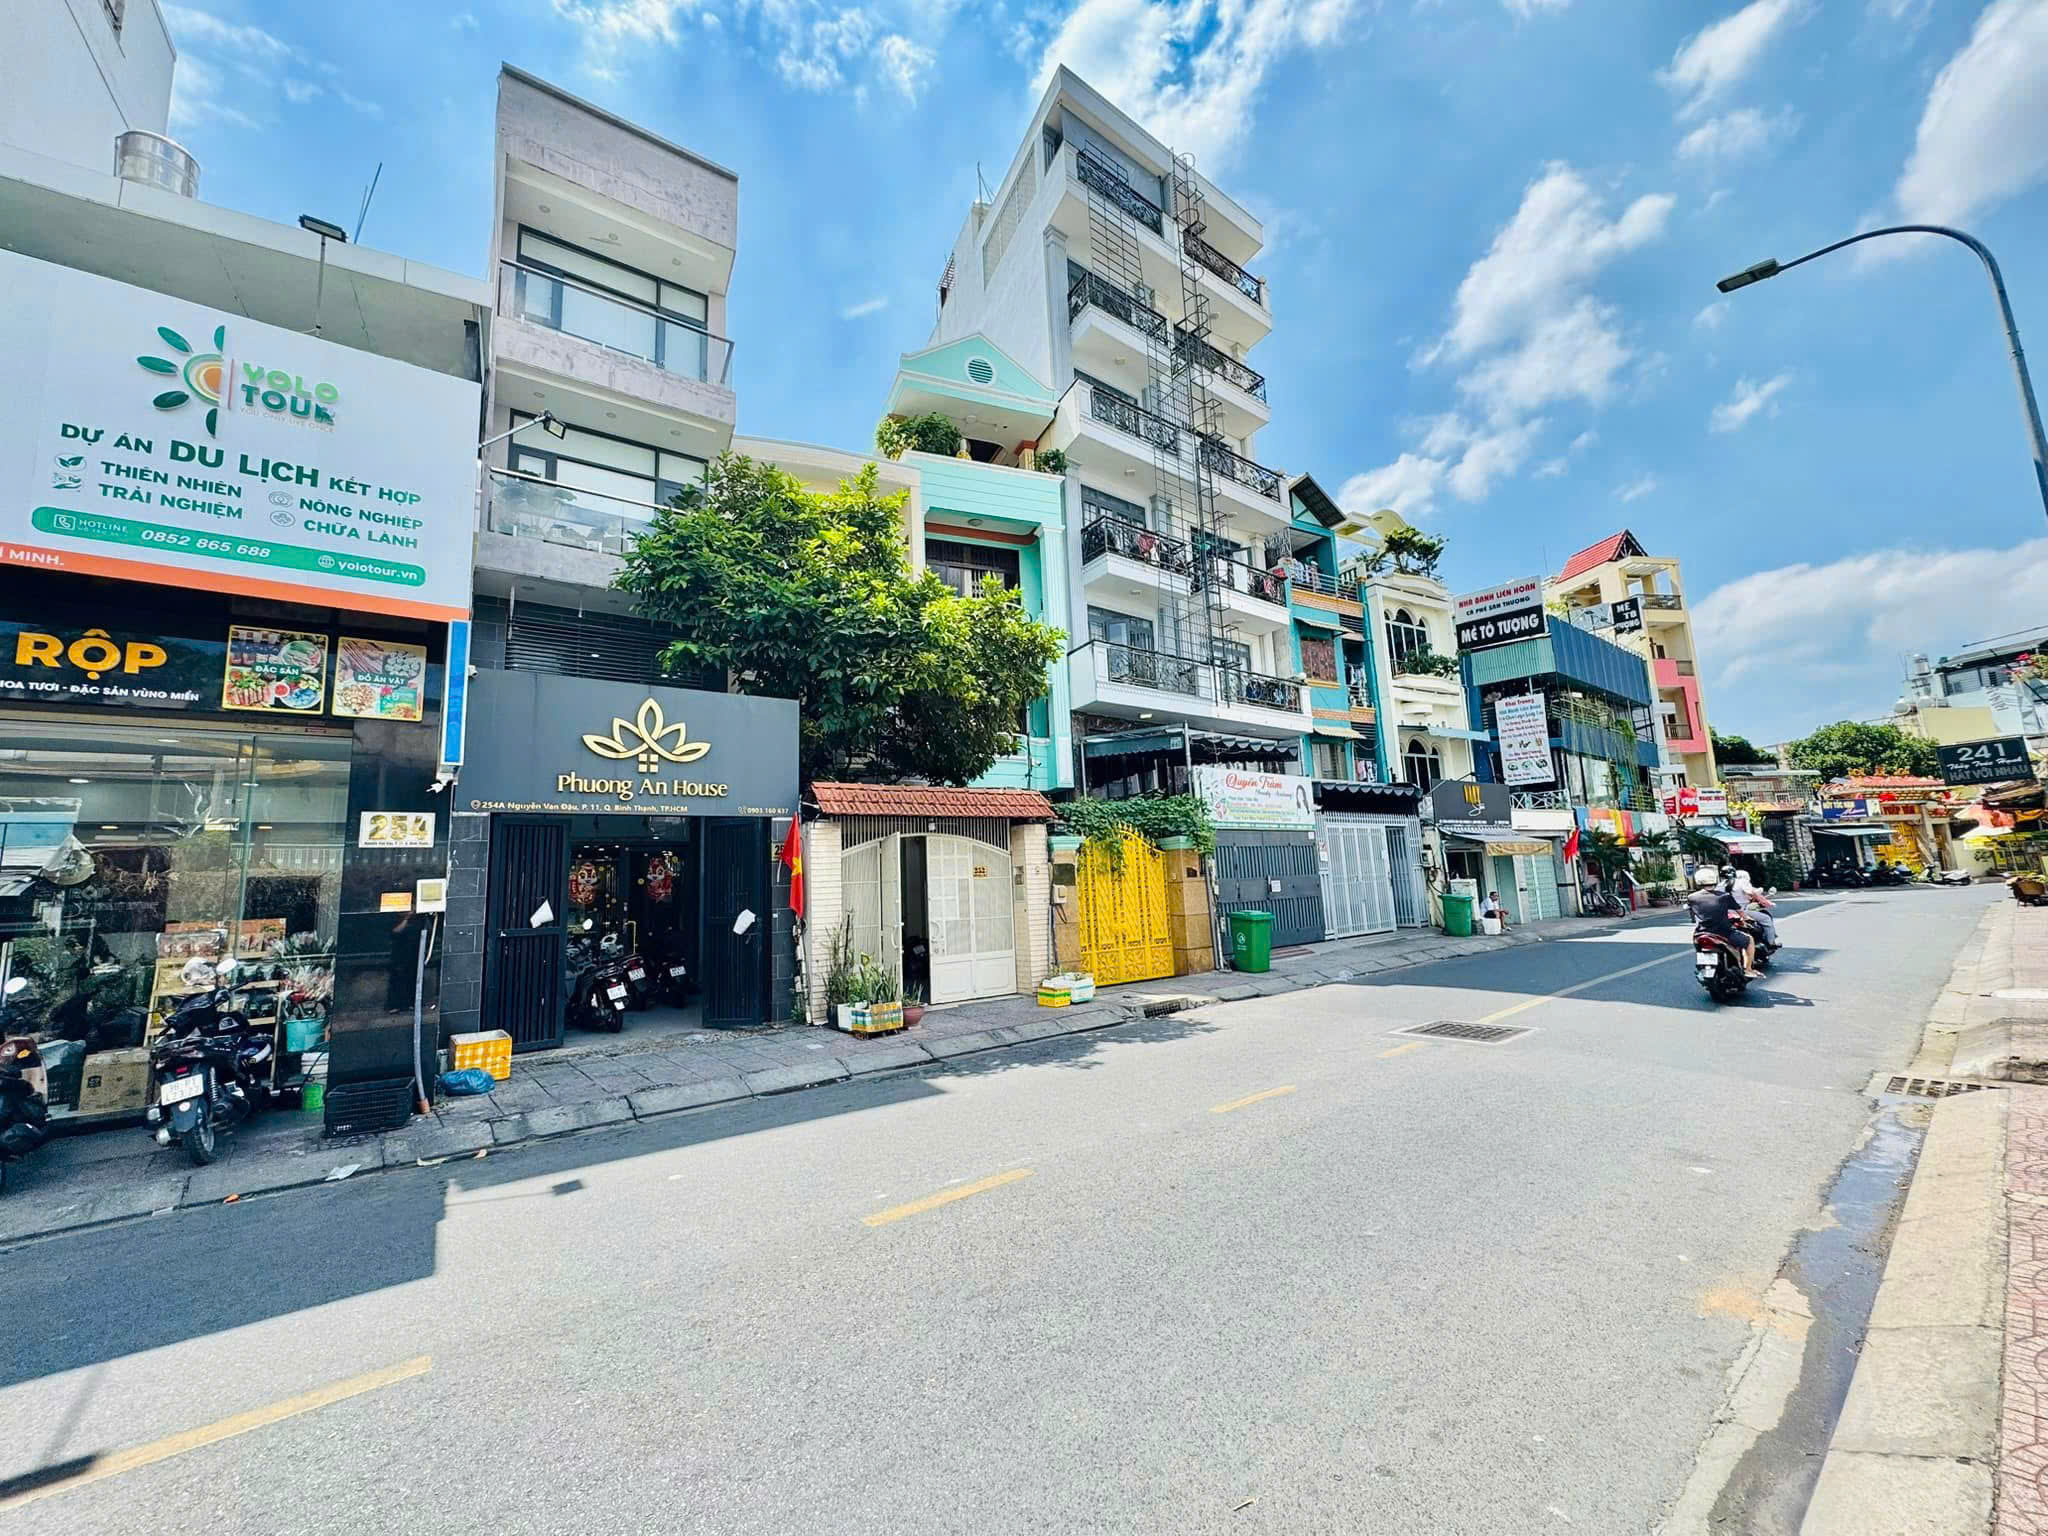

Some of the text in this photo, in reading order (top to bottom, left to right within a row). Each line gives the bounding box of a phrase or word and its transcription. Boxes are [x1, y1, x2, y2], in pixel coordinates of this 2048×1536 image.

[243, 362, 339, 404] YOLO
[241, 384, 336, 425] TOUR
[61, 423, 421, 506] DỰ ÁN DU LỊCH KẾT HỢP
[100, 461, 242, 498] THIÊN NHIÊN
[99, 483, 243, 519] TRẢI NGHIỆM
[300, 498, 423, 531] NÔNG NGHIỆP
[80, 519, 128, 532] HOTLINE
[303, 519, 418, 549] CHỮA LÀNH
[9, 549, 64, 566] MINH.
[141, 529, 189, 546] 0852
[196, 538, 231, 553] 865
[236, 544, 271, 558] 688
[338, 560, 418, 580] yolotour.vn
[15, 628, 168, 680] RỘP
[28, 682, 59, 692] TƯƠI
[70, 684, 100, 696] ĐẶC
[103, 684, 128, 696] SẢN
[132, 687, 167, 699] VÙNG
[170, 689, 199, 702] MIỀN
[1956, 743, 2006, 761] 241
[557, 771, 728, 800] Phuong An House
[481, 801, 505, 809] 254A
[368, 814, 428, 840] 254
